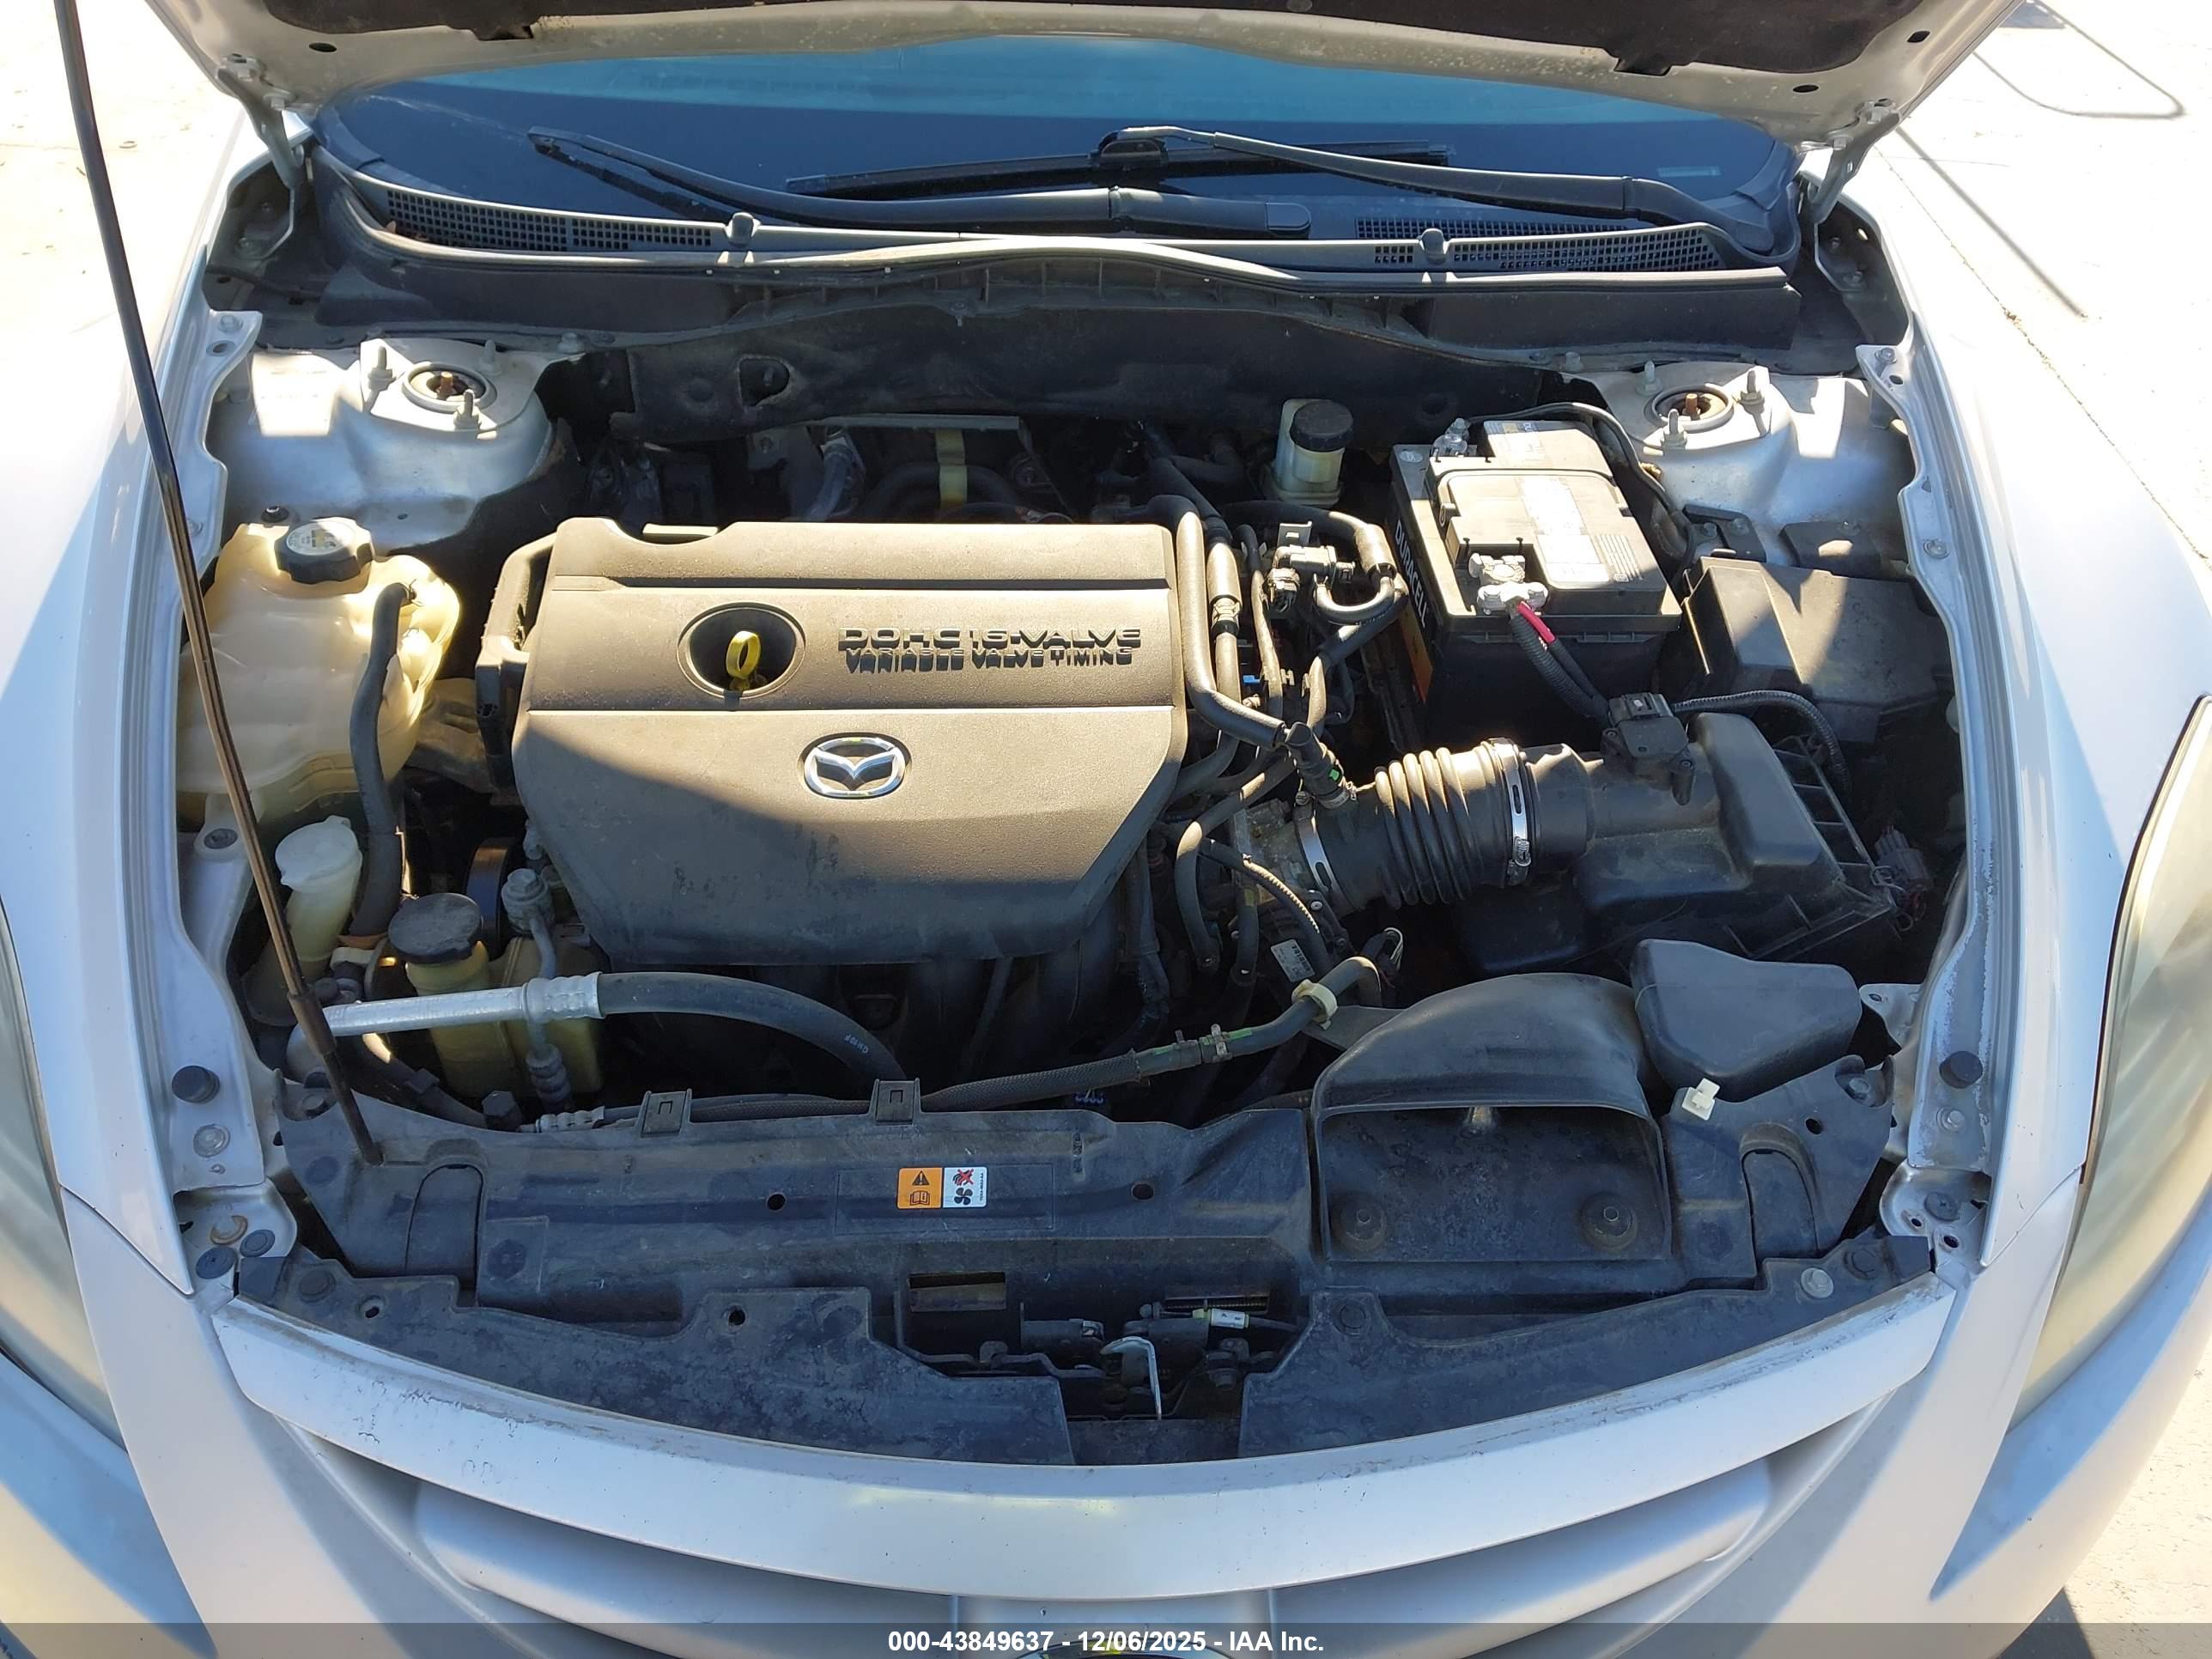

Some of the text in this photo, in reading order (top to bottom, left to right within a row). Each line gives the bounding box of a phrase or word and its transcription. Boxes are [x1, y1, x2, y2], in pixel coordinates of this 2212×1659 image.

[1395, 519, 1426, 628] DURACELL
[838, 627, 1141, 650] DOHC 16-VALVE
[845, 646, 1133, 673] VARIABLE VALVE TIMING
